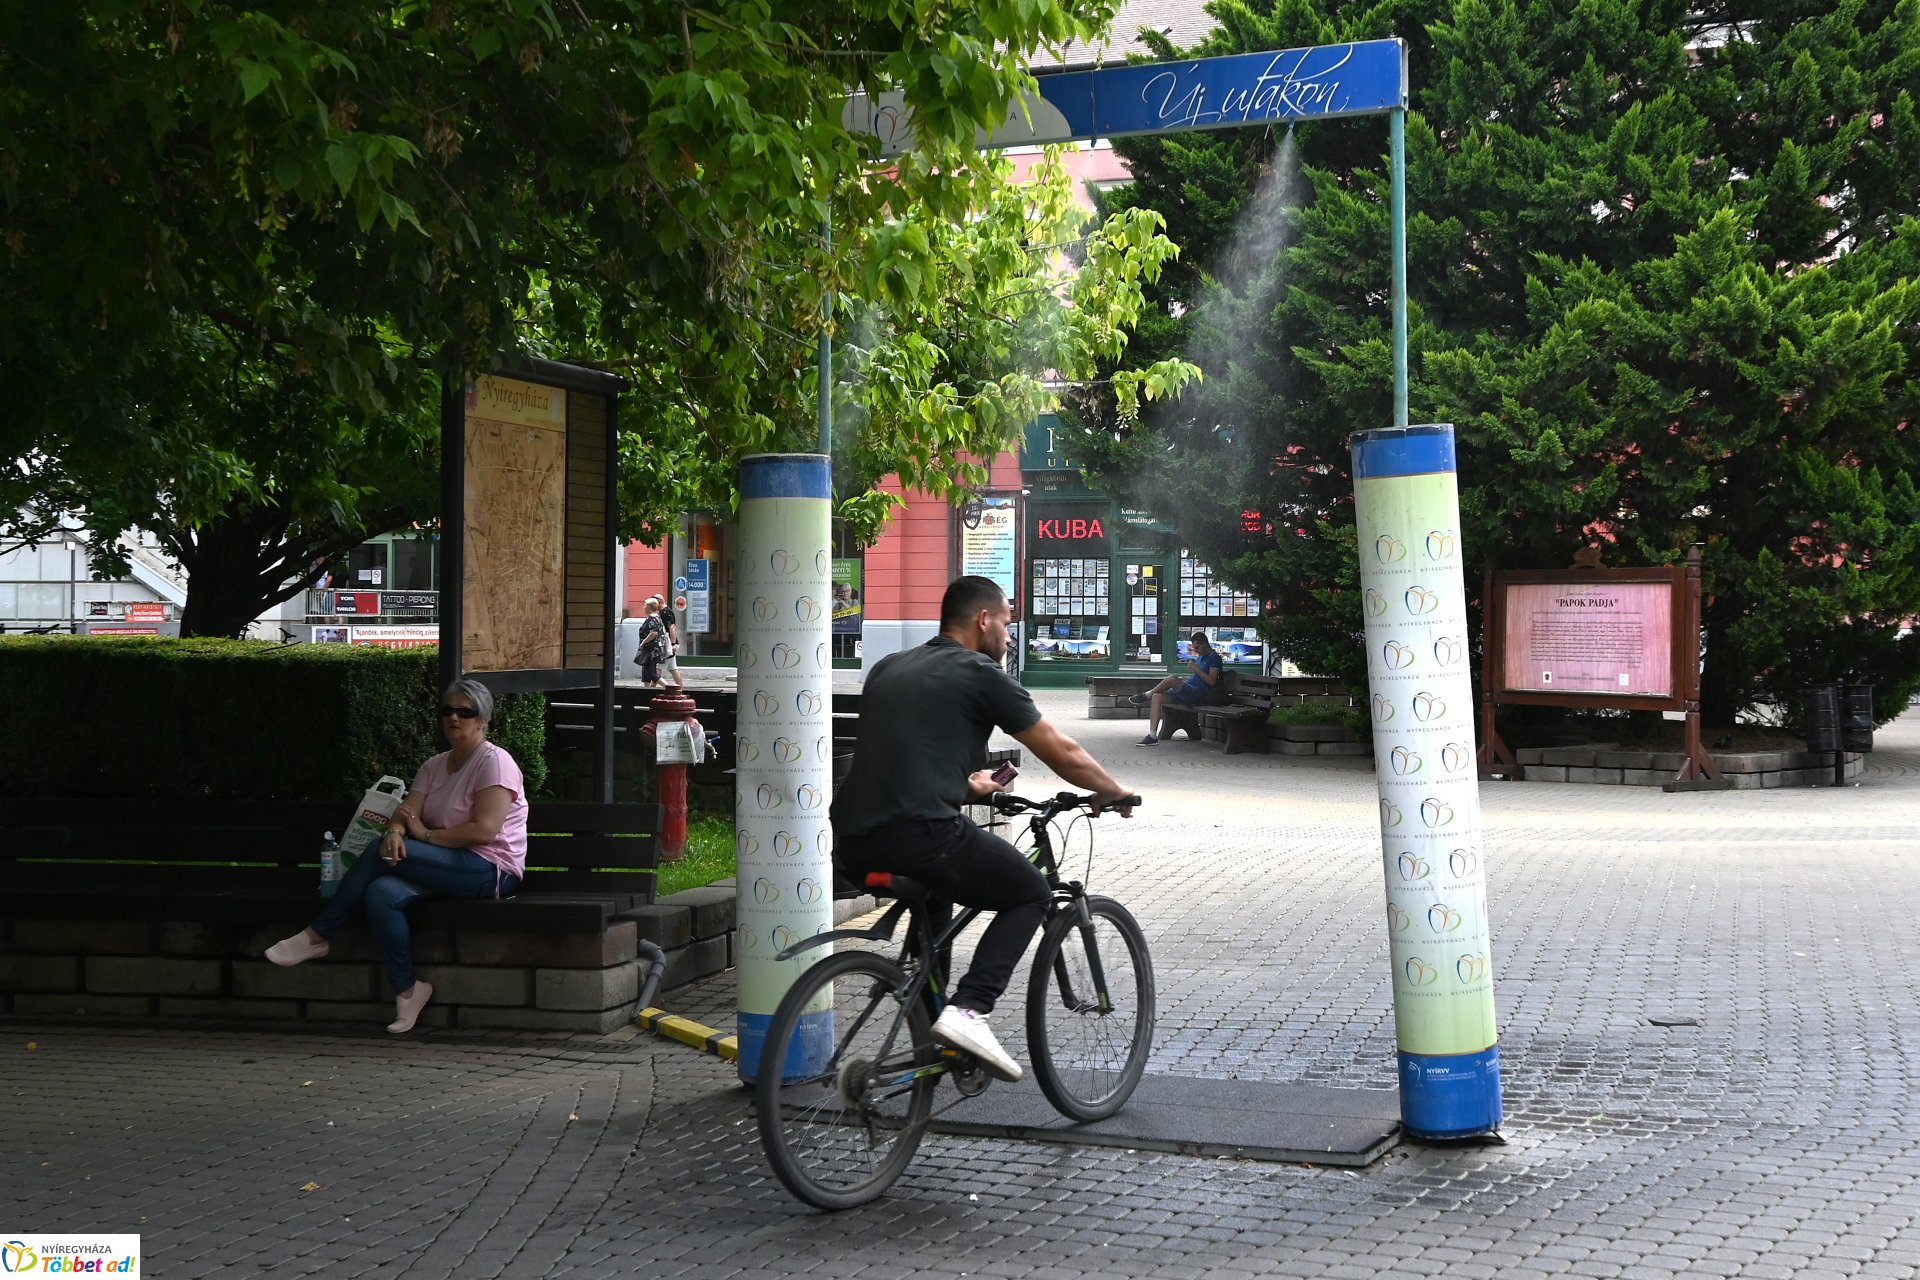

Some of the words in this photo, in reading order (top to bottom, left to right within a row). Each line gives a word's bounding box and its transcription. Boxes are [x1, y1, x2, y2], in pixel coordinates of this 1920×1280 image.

[1142, 64, 1222, 127] Új
[482, 380, 548, 412] Nyíregyháza
[1038, 518, 1104, 539] KUBA
[382, 596, 405, 604] TATTOO
[408, 596, 435, 604] PIERCING
[1556, 598, 1586, 607] "PAPOK
[1588, 598, 1619, 608] PADJA"
